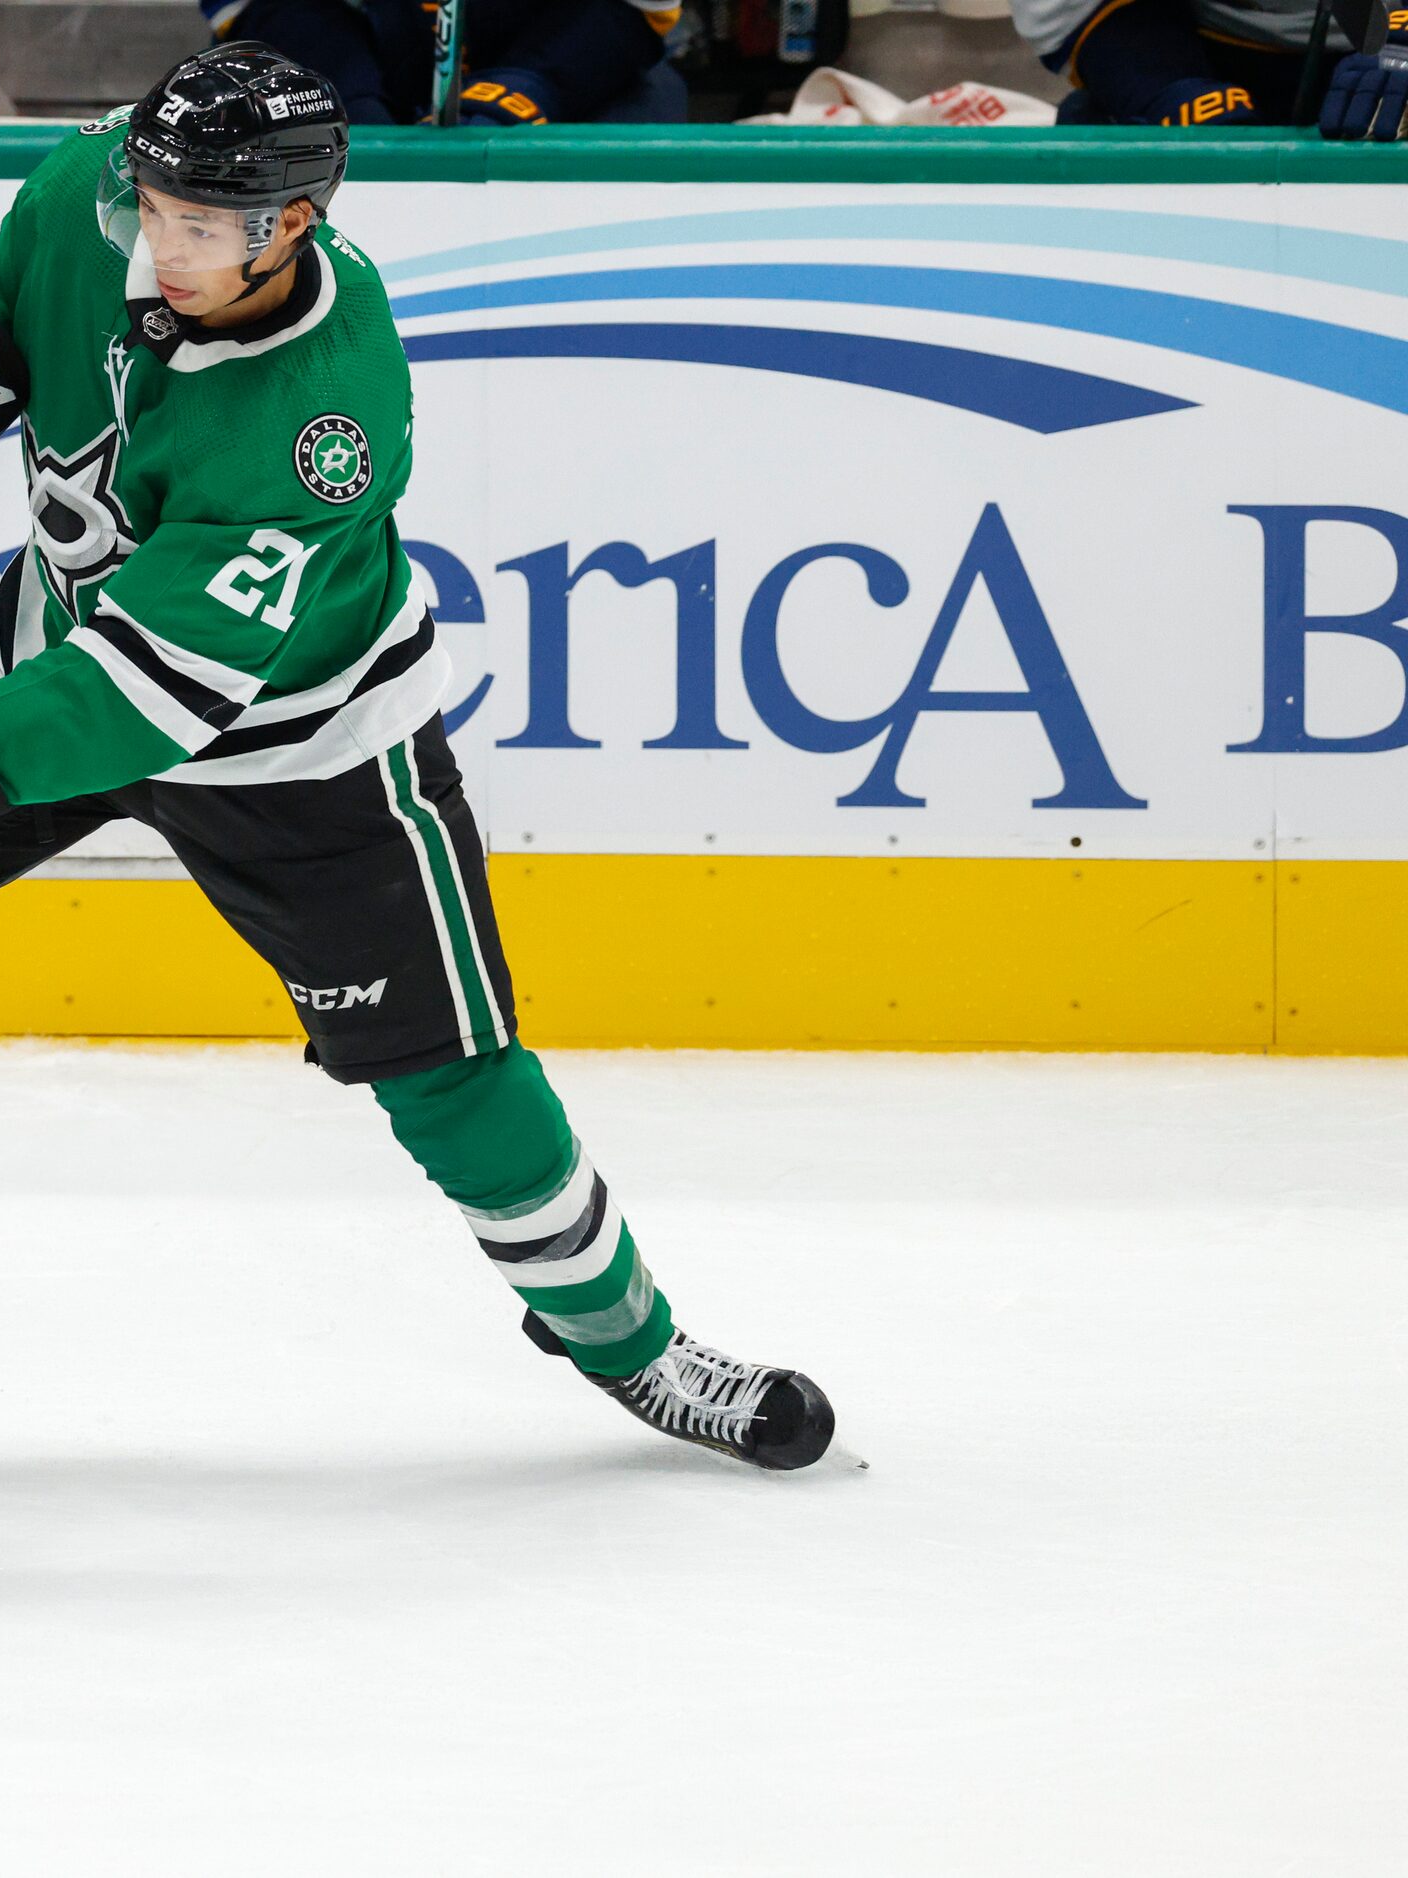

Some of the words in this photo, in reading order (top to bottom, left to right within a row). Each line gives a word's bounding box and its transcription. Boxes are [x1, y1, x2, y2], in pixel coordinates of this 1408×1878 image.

[156, 94, 192, 126] 21
[287, 88, 322, 104] ENERGY
[290, 99, 334, 116] TRANSFER
[135, 137, 181, 167] CCM
[301, 421, 366, 454] DALLAS
[308, 472, 367, 497] STARS
[205, 529, 322, 633] 21
[285, 977, 388, 1011] CCM
